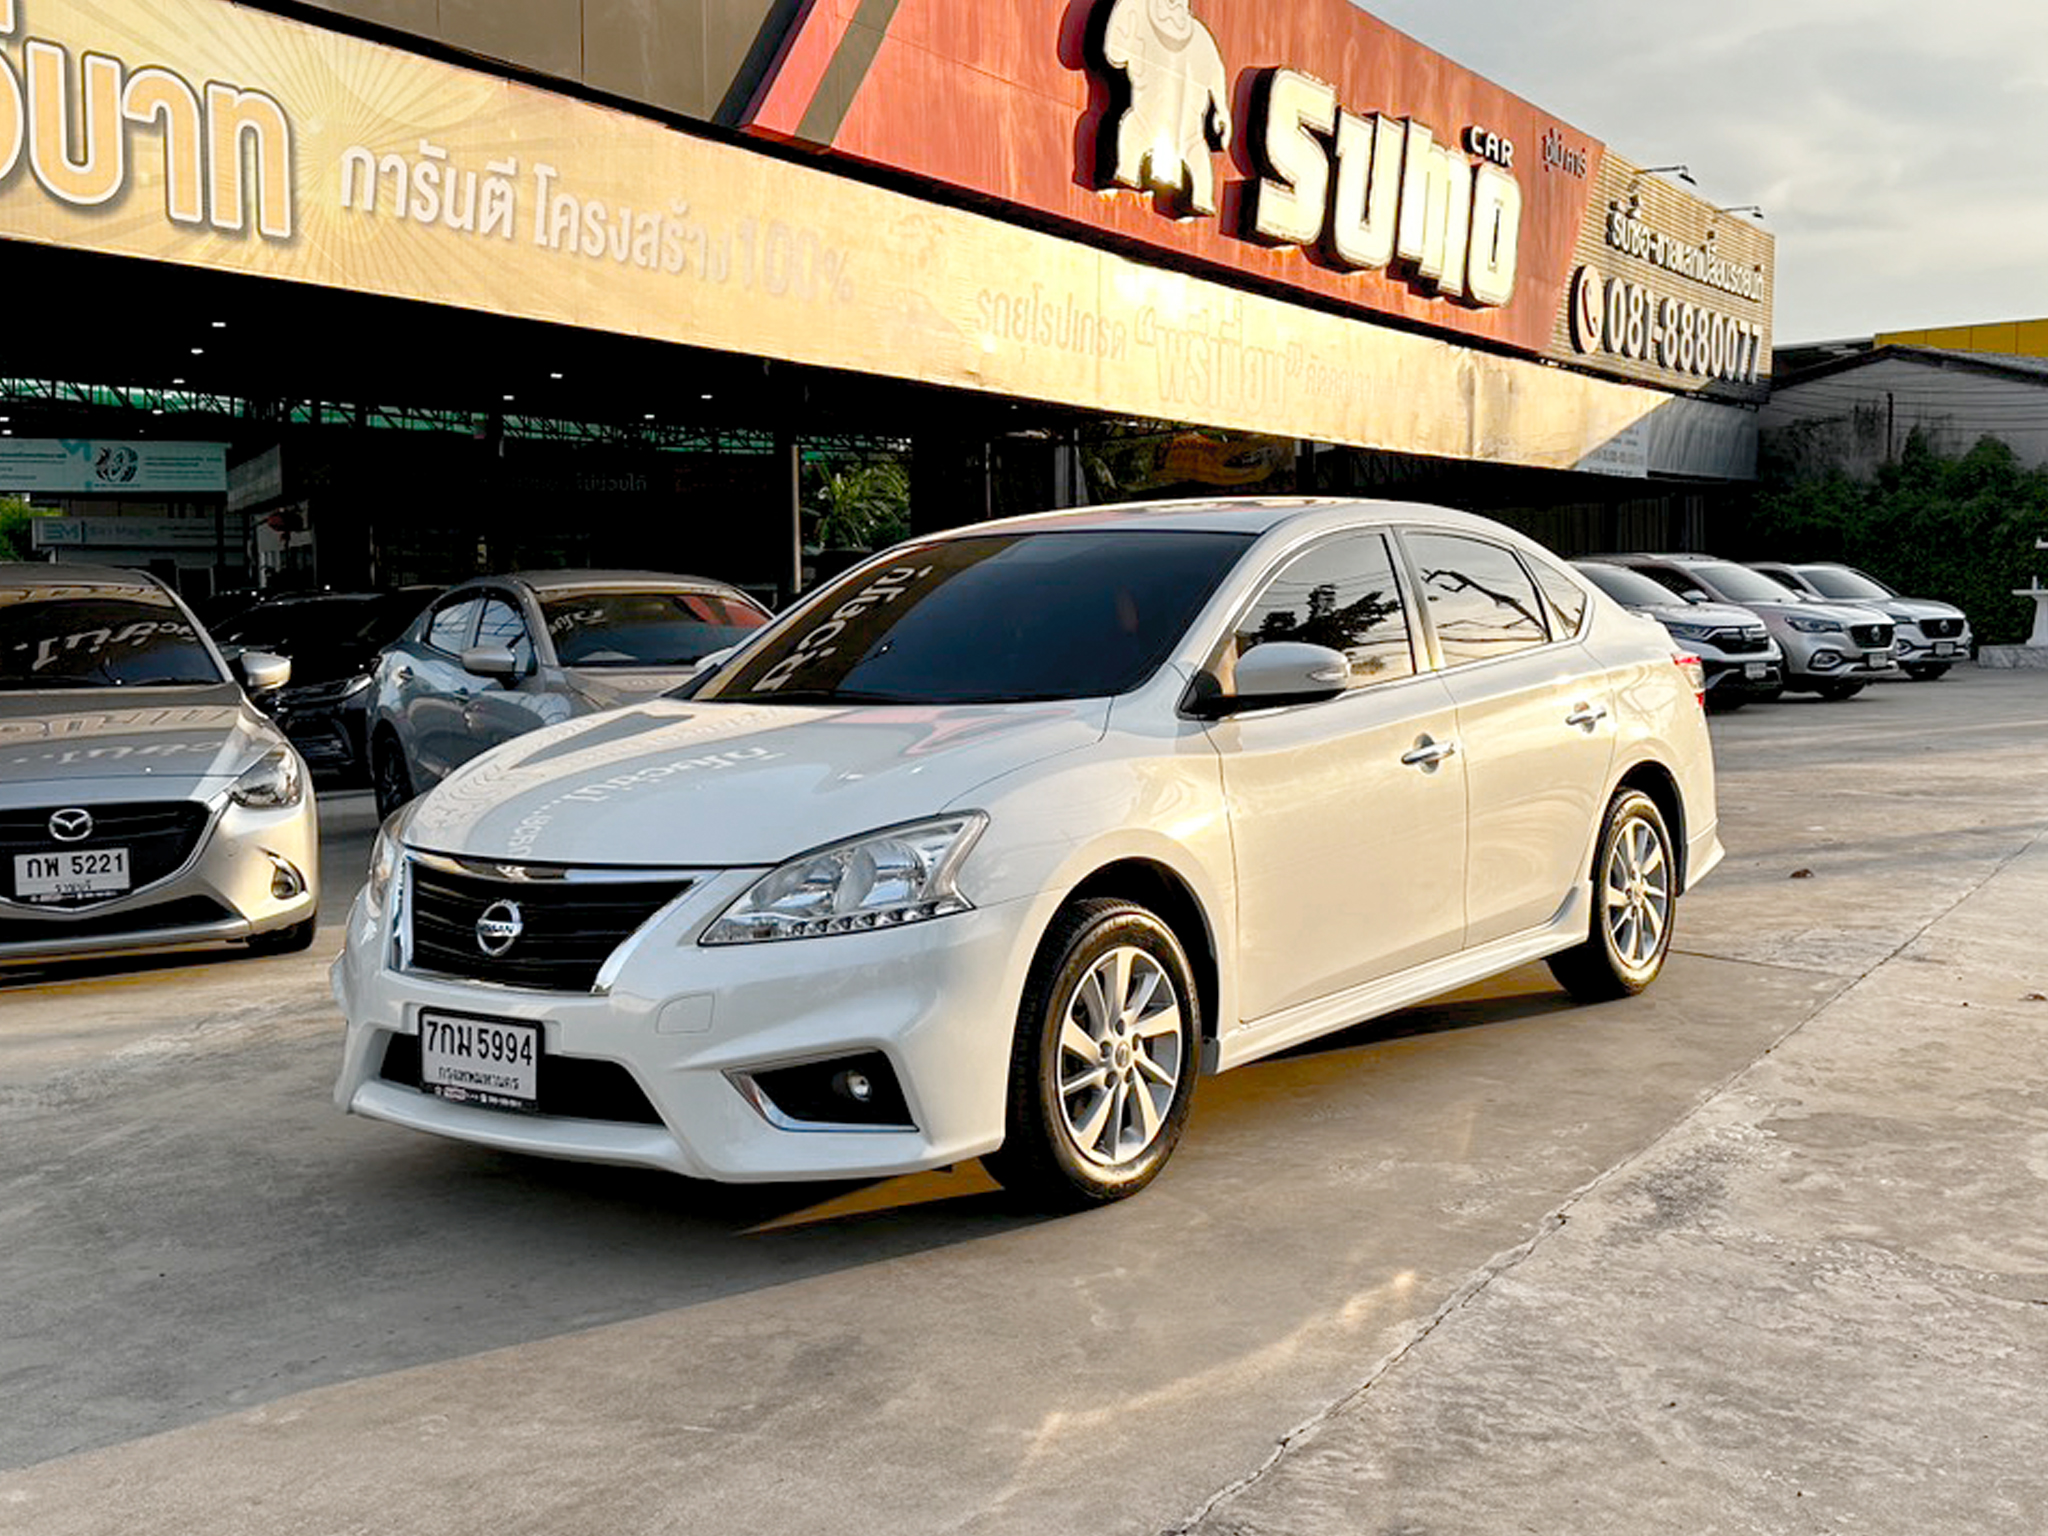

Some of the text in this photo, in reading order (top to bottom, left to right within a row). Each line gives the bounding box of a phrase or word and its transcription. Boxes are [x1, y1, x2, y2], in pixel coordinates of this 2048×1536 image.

[0, 37, 292, 239] บาท
[1470, 125, 1514, 168] CAR
[340, 138, 518, 240] การันตี
[1608, 276, 1763, 384] 081-8880077
[71, 852, 123, 875] 5221
[426, 1020, 533, 1066] 7กม 5994
